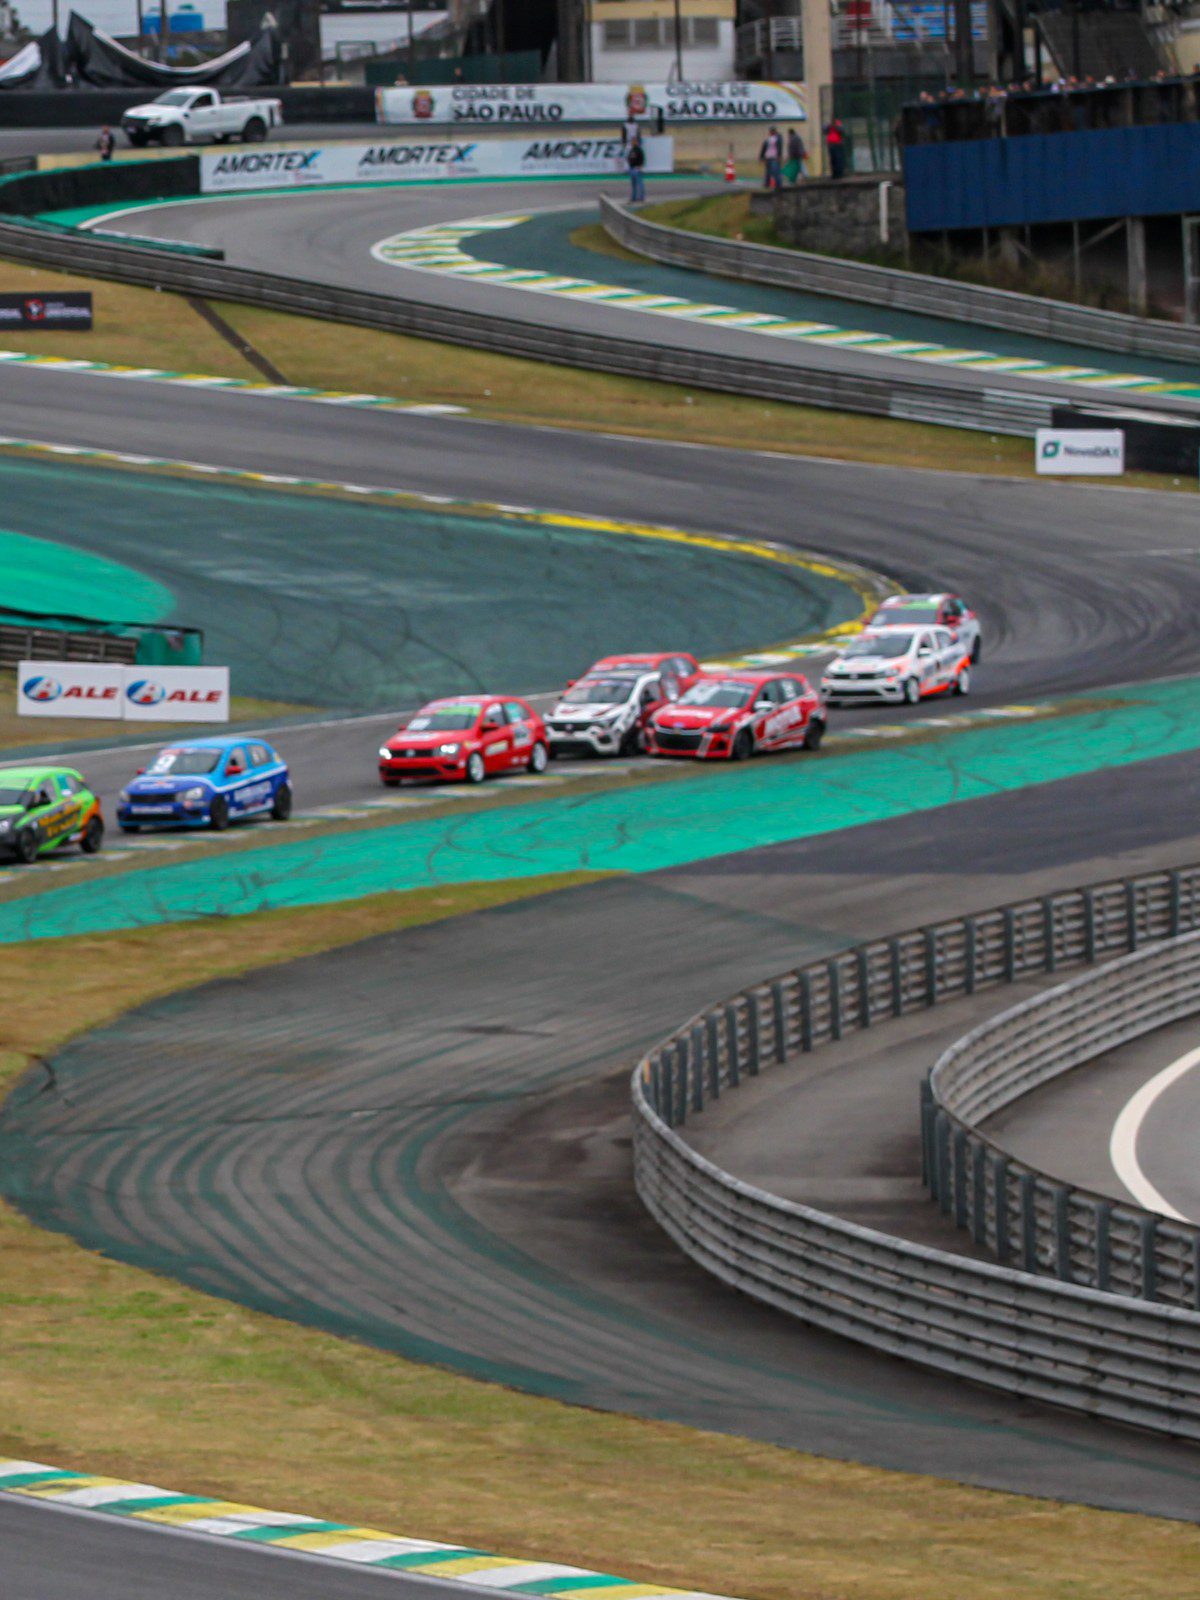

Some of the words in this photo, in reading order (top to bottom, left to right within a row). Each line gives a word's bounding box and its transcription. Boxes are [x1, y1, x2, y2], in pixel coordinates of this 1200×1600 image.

[452, 86, 508, 101] CIDADE
[512, 86, 536, 101] DE
[667, 83, 724, 98] CIDADE
[728, 84, 751, 99] DE
[452, 98, 495, 121] SÃO
[499, 101, 563, 121] PAULO
[668, 96, 709, 118] SÃO
[714, 101, 776, 118] PAULO
[212, 149, 322, 175] AMORTEX
[357, 143, 480, 166] AMORTEX
[63, 686, 119, 700] ALE
[167, 690, 223, 703] ALE
